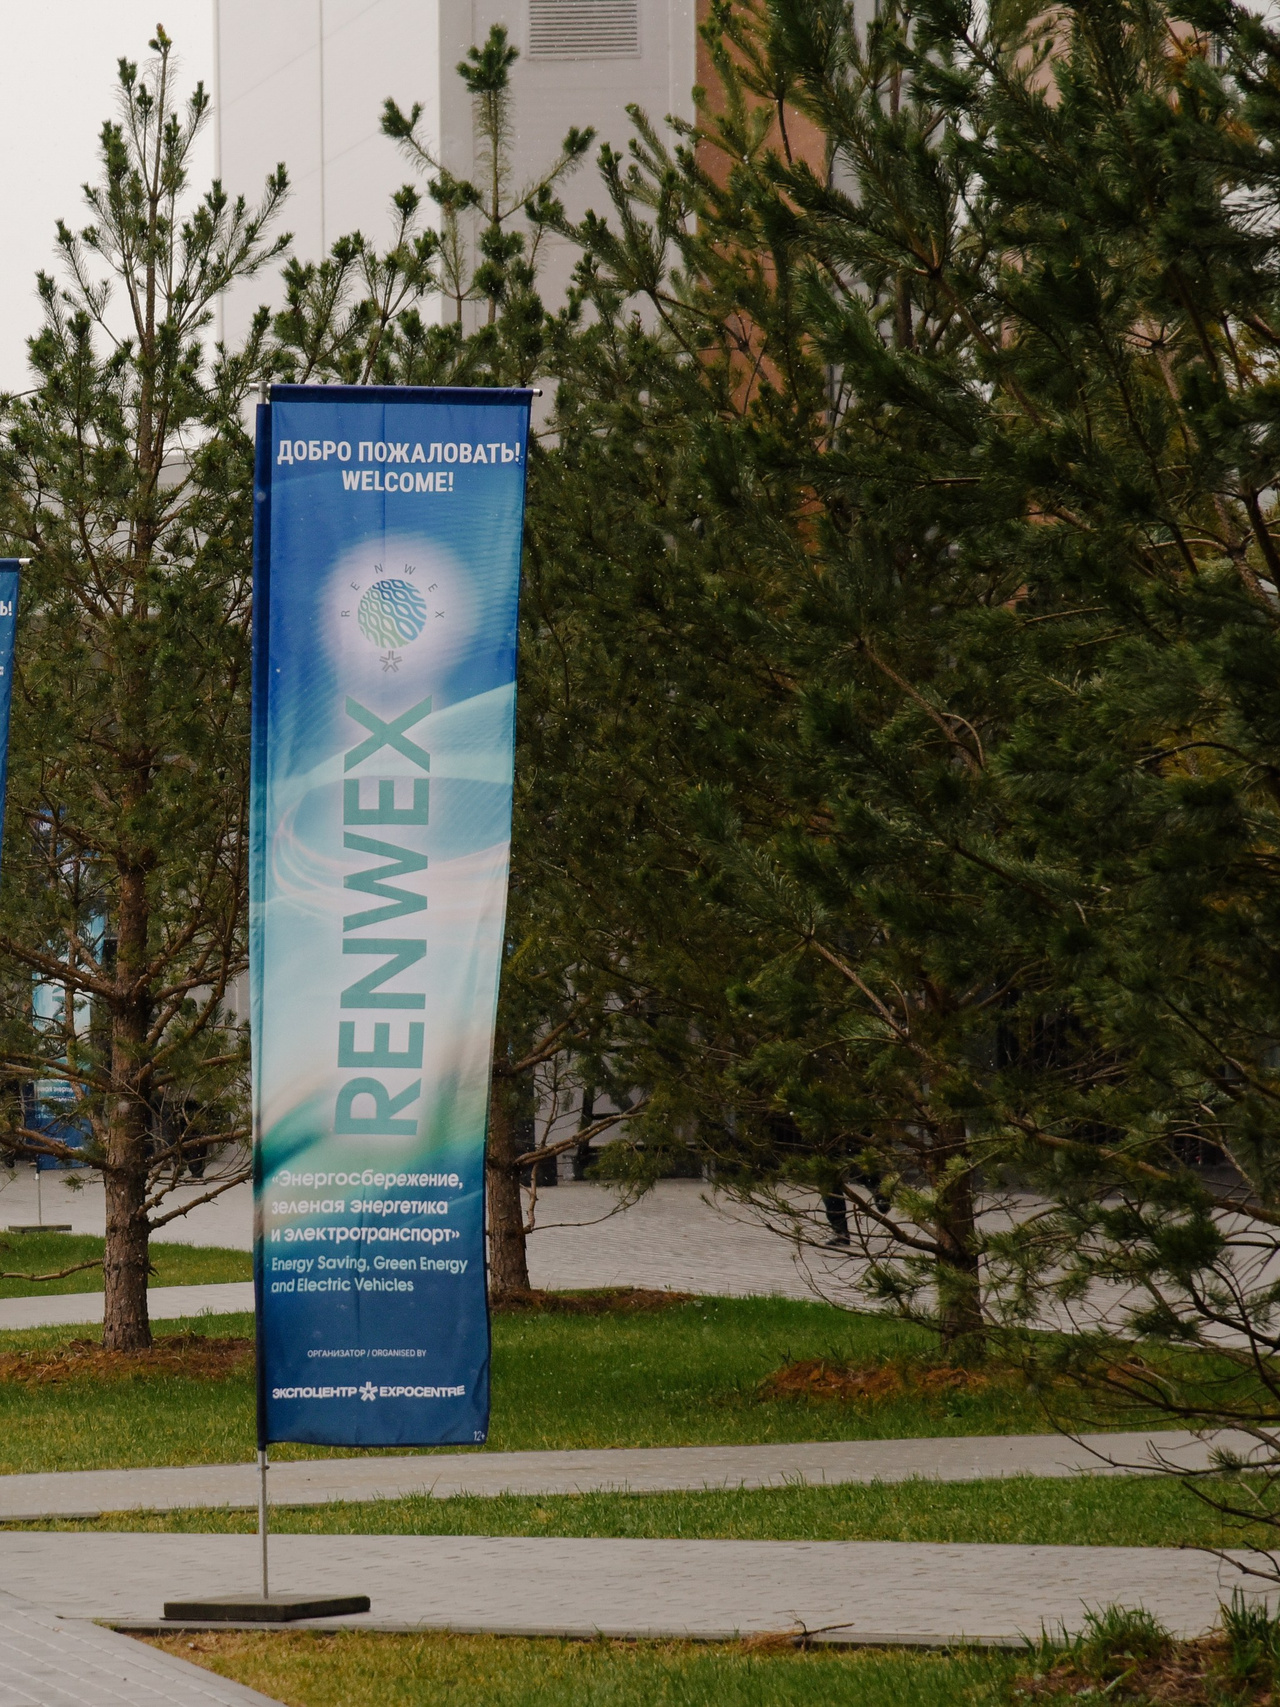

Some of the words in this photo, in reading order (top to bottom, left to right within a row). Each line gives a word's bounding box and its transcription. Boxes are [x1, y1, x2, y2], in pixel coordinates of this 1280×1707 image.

[277, 440, 352, 465] ДОБРО
[358, 441, 521, 464] ПОЖАЛОВАТЬ!
[342, 470, 454, 492] WELCOME!
[340, 563, 445, 619] RENWEX
[334, 694, 433, 1136] RENWEX
[272, 1169, 463, 1190] «Энергосбережение,
[271, 1200, 345, 1214] зеленая
[350, 1200, 448, 1217] энергетика
[271, 1228, 280, 1242] и
[284, 1226, 460, 1245] электротранспорт»
[271, 1257, 314, 1273] Energy
[317, 1255, 370, 1273] Saving,
[373, 1256, 417, 1270] Green
[420, 1257, 468, 1274] Energy
[271, 1278, 295, 1293] and
[297, 1277, 351, 1292] Electric
[354, 1277, 414, 1292] Vehicles
[307, 1349, 366, 1358] ОРГАНИЗАТОР
[372, 1349, 415, 1357] ORGANISED
[417, 1349, 427, 1357] BY
[272, 1386, 358, 1399] ЭКСПОЦЕНТР
[379, 1385, 466, 1398] EXPOCENTRE
[473, 1430, 486, 1441] 12+
